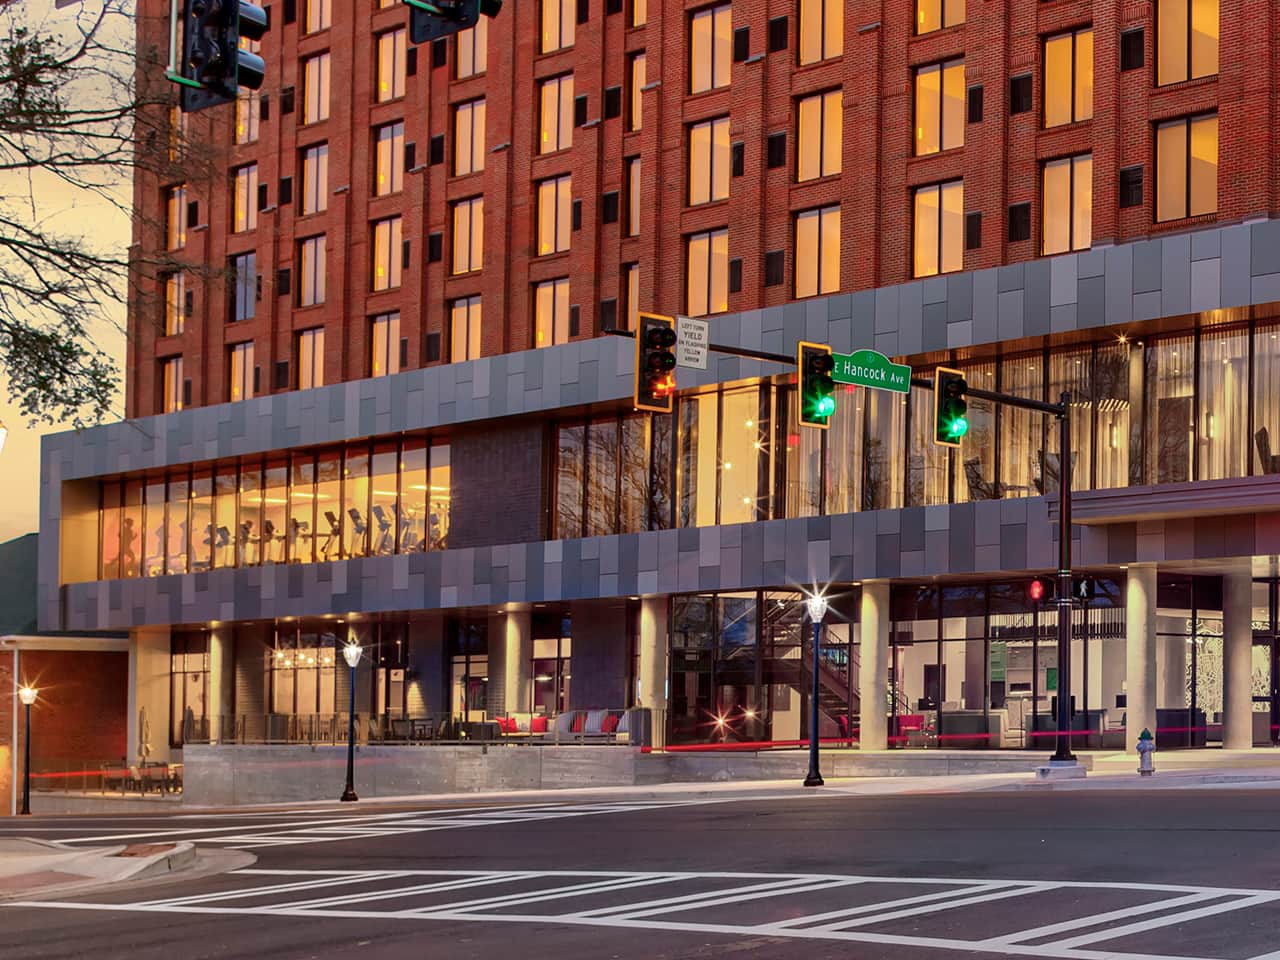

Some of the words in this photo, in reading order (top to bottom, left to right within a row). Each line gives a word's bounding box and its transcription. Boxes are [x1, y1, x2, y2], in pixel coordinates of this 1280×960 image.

[684, 330, 703, 340] YIELD
[834, 362, 839, 373] E
[843, 360, 886, 381] Hancock
[890, 372, 904, 384] Ave
